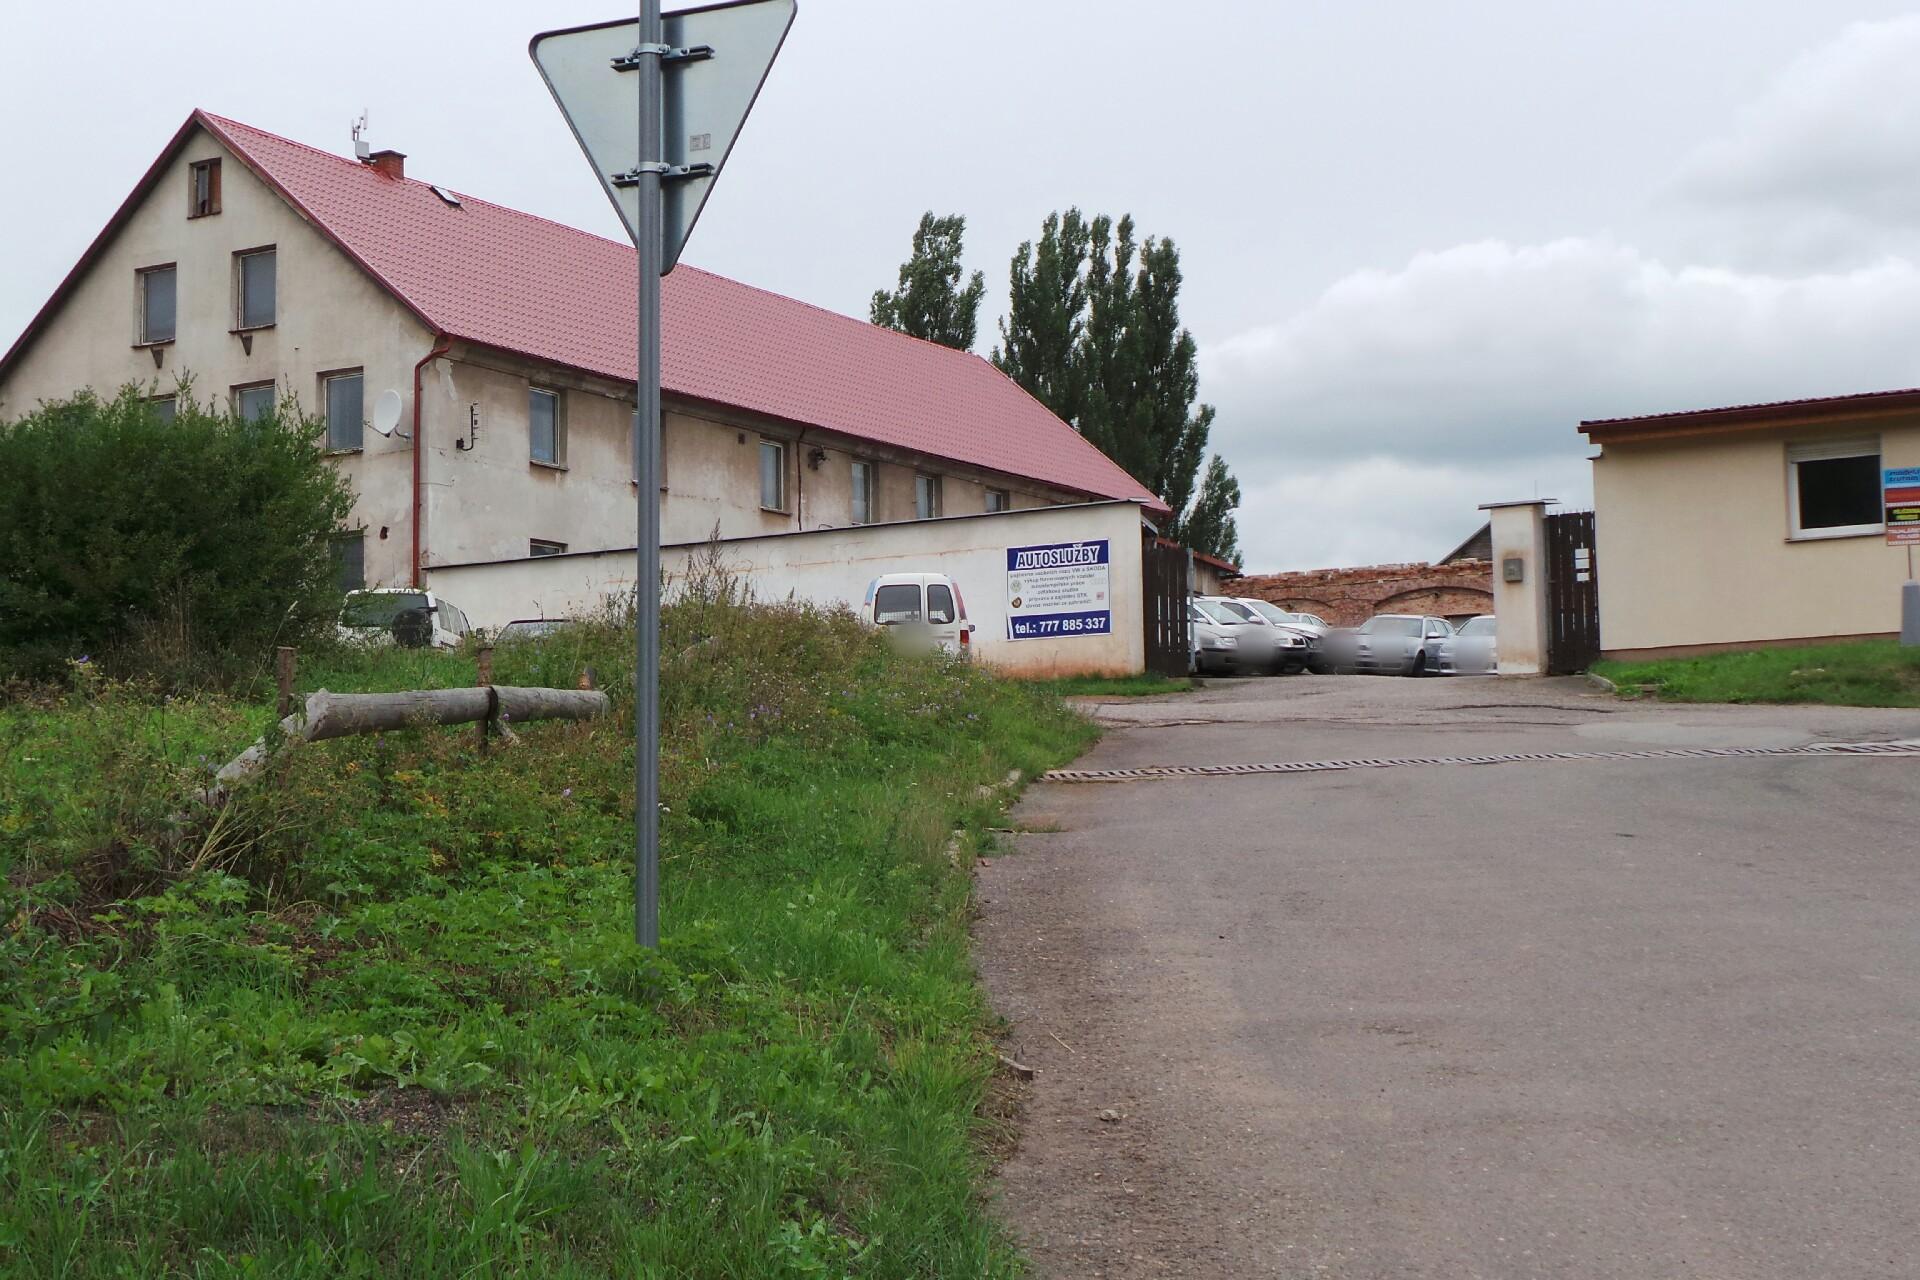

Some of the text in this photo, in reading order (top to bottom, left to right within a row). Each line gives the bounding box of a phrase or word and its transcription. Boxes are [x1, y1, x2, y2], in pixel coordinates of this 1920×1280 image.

[1016, 544, 1099, 568] AUTOSLUŽBY
[1015, 617, 1106, 634] tel.: 777 885 337
